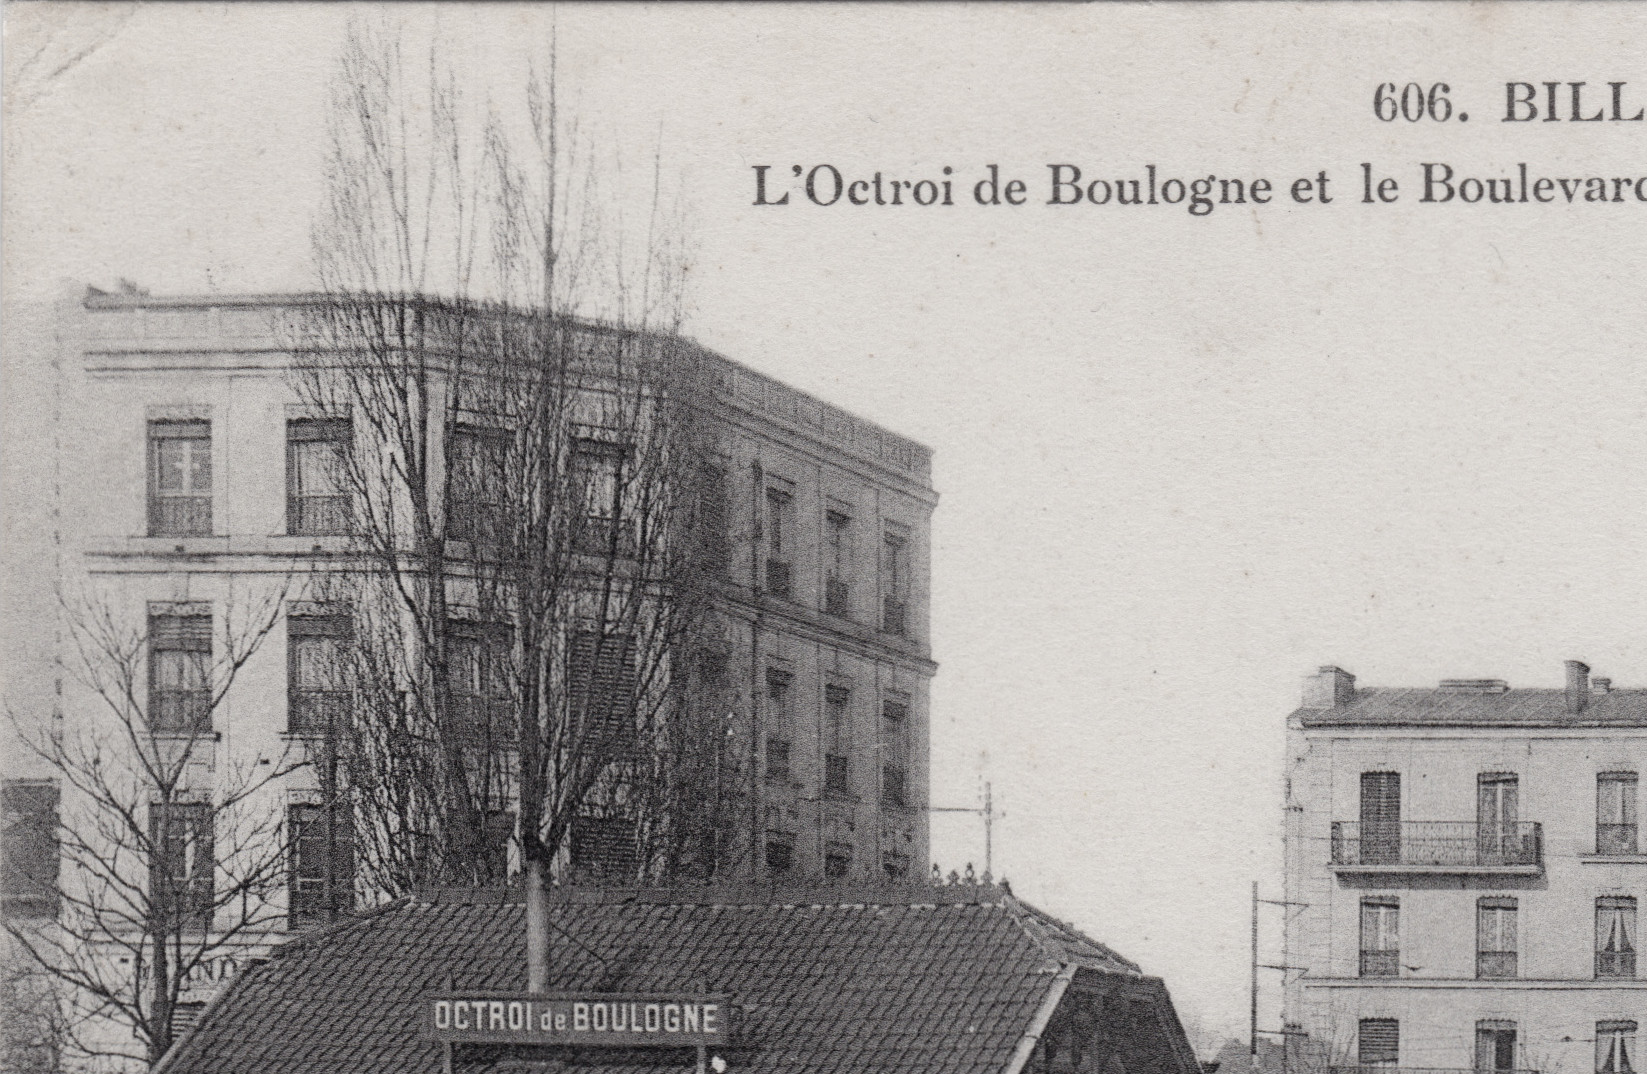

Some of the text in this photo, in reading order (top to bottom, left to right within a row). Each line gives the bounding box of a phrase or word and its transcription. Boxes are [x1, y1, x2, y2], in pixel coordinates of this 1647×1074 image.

[434, 1000, 718, 1034] OCTROI de BOULOGNE
